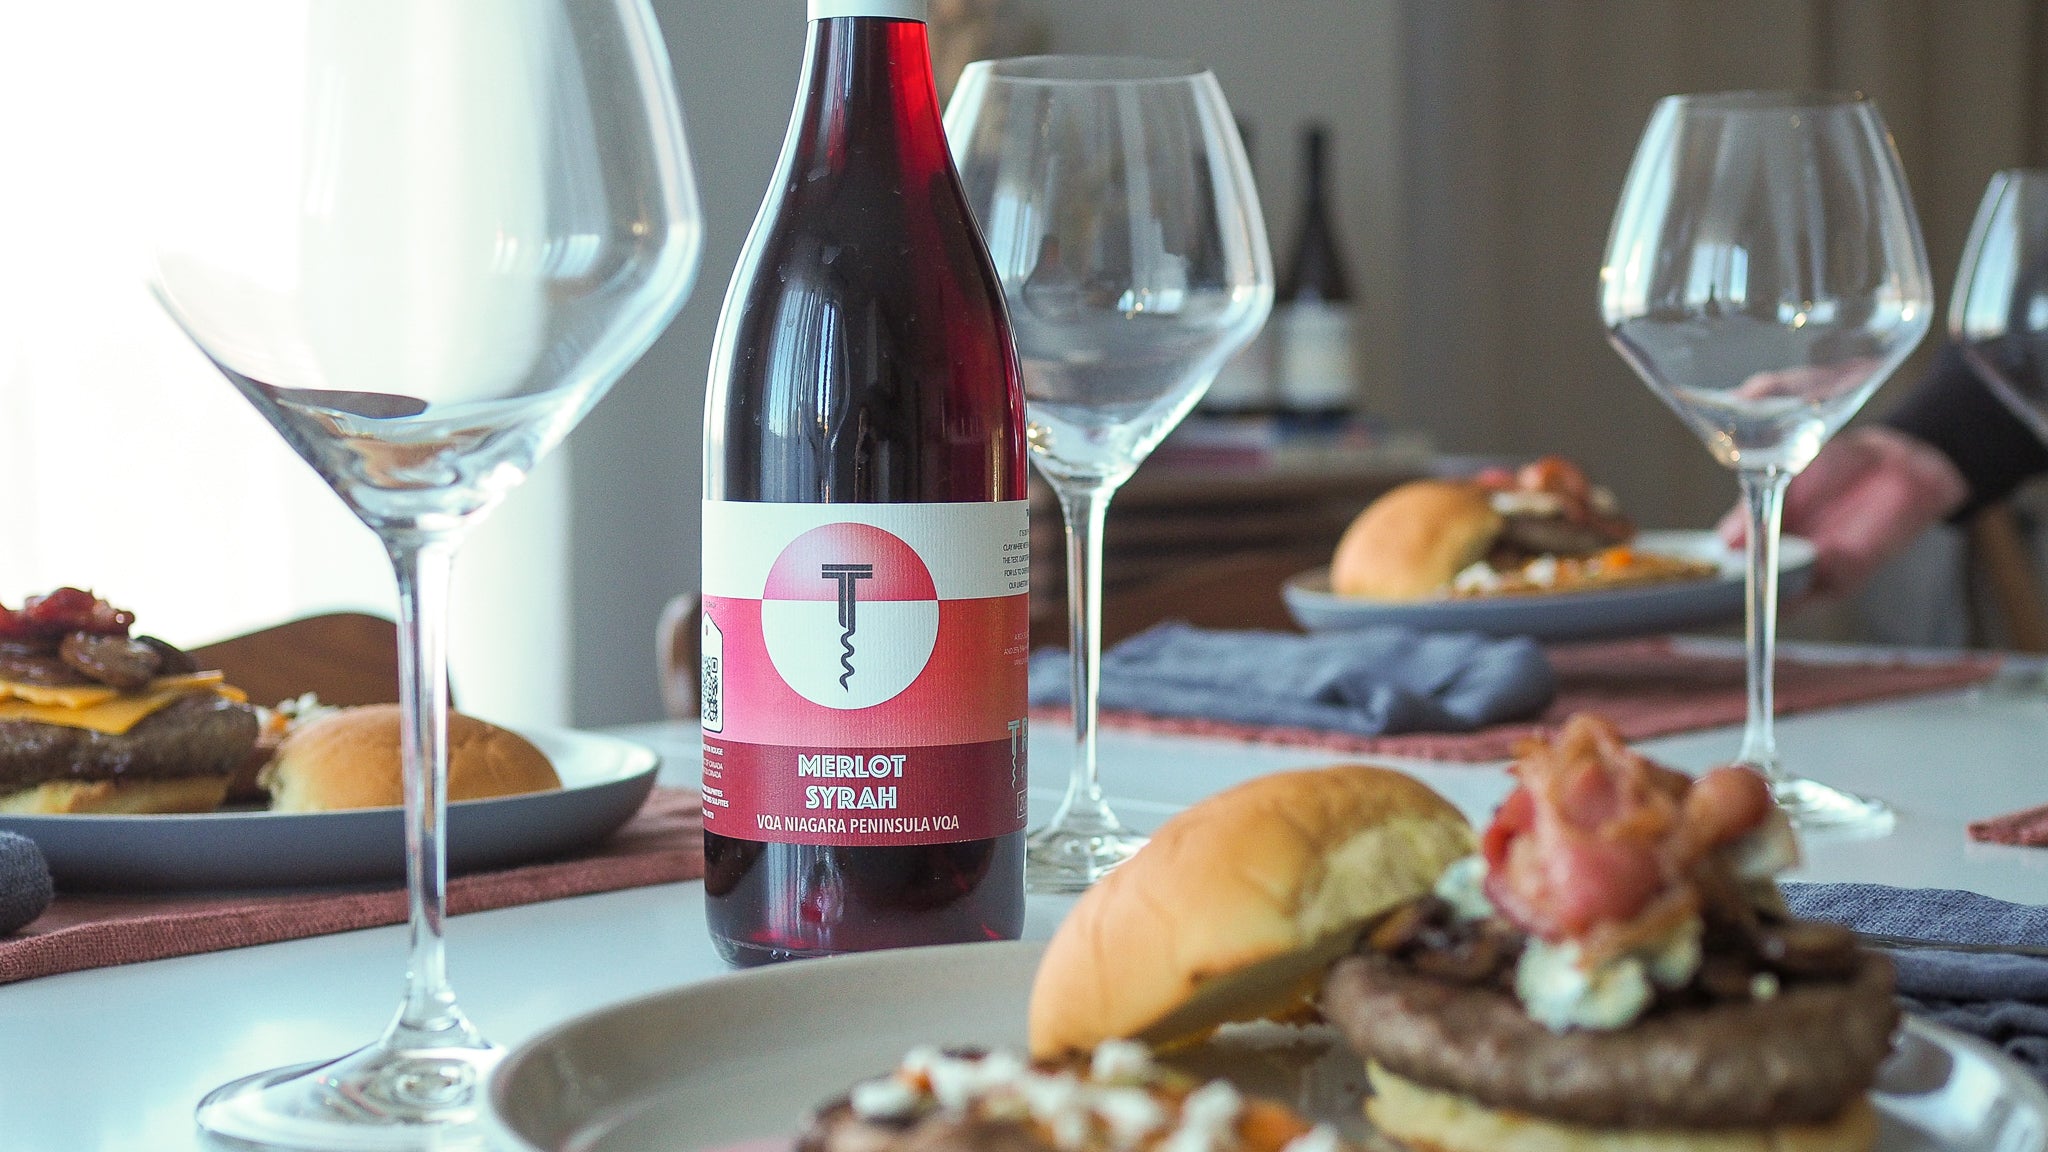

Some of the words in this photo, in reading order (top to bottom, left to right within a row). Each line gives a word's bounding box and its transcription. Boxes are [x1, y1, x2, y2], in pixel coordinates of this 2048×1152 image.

[797, 754, 906, 779] MERLOT
[805, 785, 897, 810] SYRAH
[756, 813, 782, 831] VQA
[785, 816, 847, 833] NIAGARA
[850, 817, 930, 834] PENINSULA
[932, 815, 960, 830] VQA
